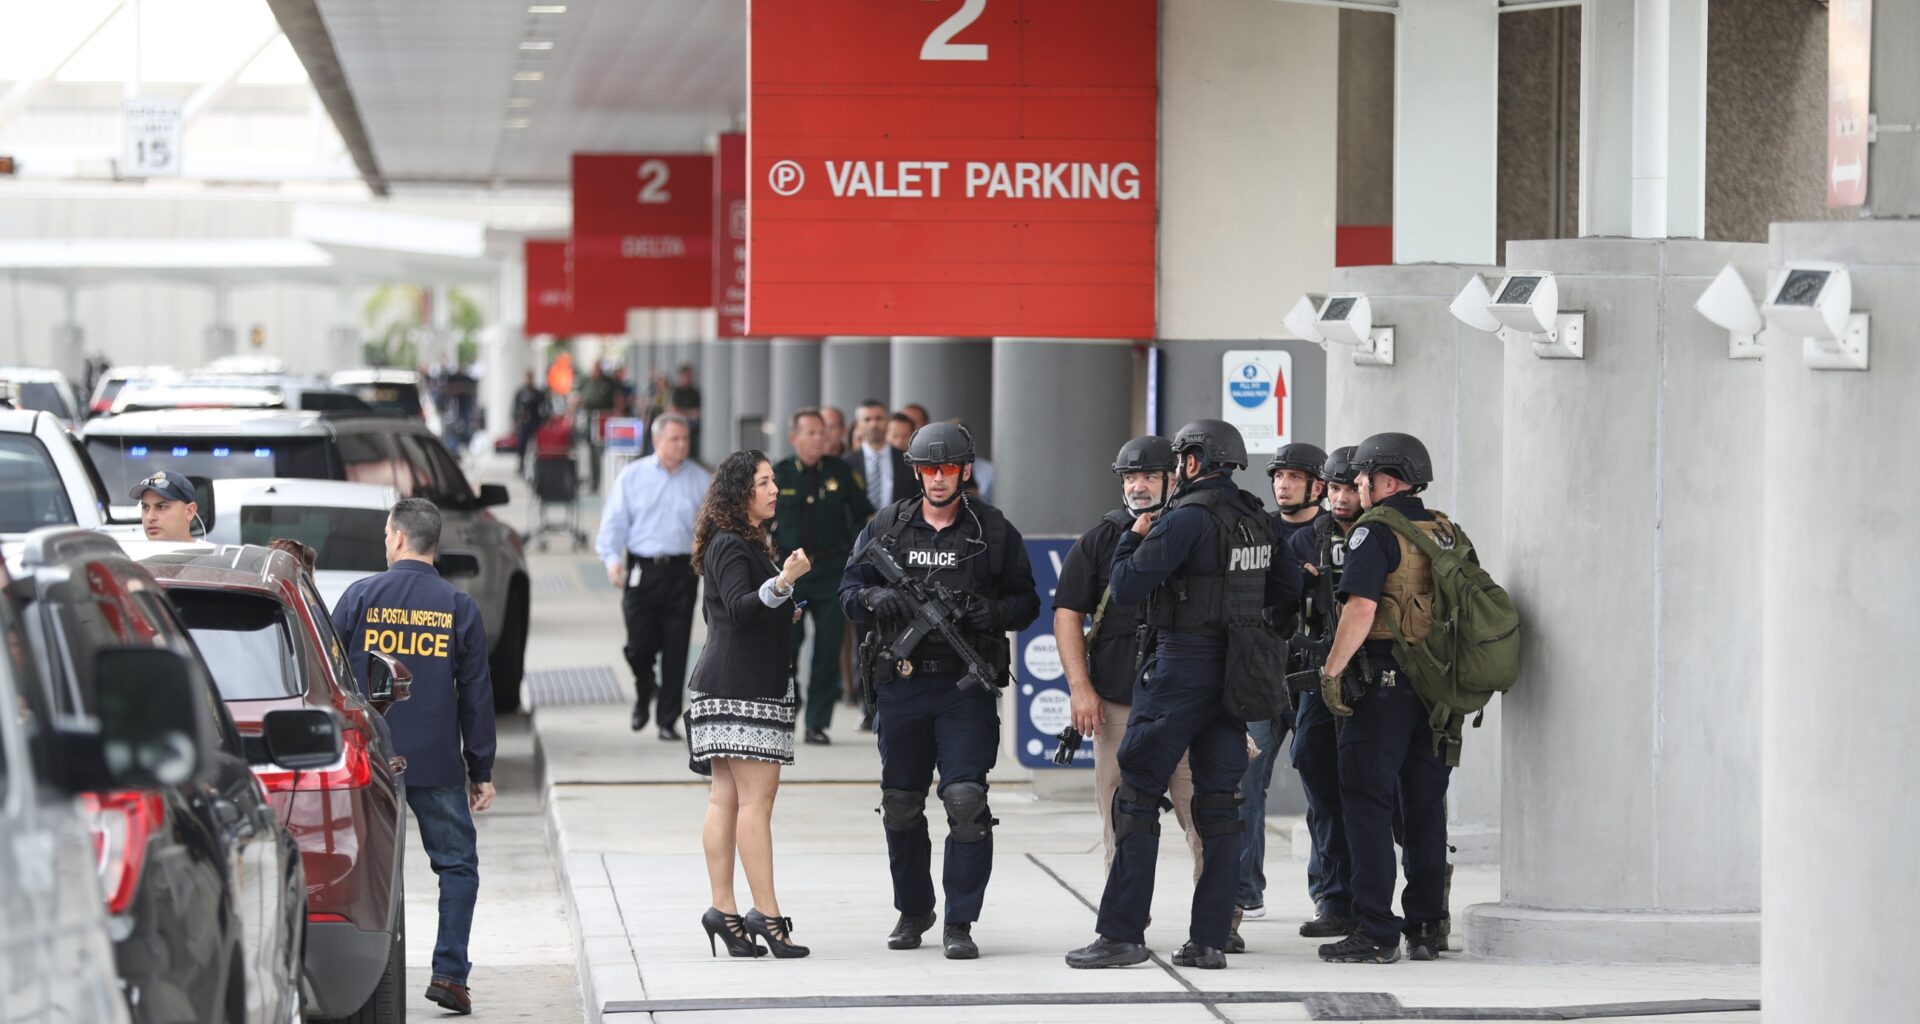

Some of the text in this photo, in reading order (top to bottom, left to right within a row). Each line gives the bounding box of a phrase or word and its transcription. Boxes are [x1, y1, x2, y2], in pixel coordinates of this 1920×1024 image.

[919, 0, 989, 61] 2
[137, 140, 171, 168] 15
[637, 160, 670, 203] 2
[825, 160, 949, 198] VALET
[965, 161, 1140, 200] PARKING
[622, 236, 685, 258] DELTA
[908, 551, 956, 566] POLICE
[1229, 544, 1272, 571] POLICE
[366, 607, 453, 629] U.S. POSTAL INSPECTOR
[363, 629, 449, 657] POLICE
